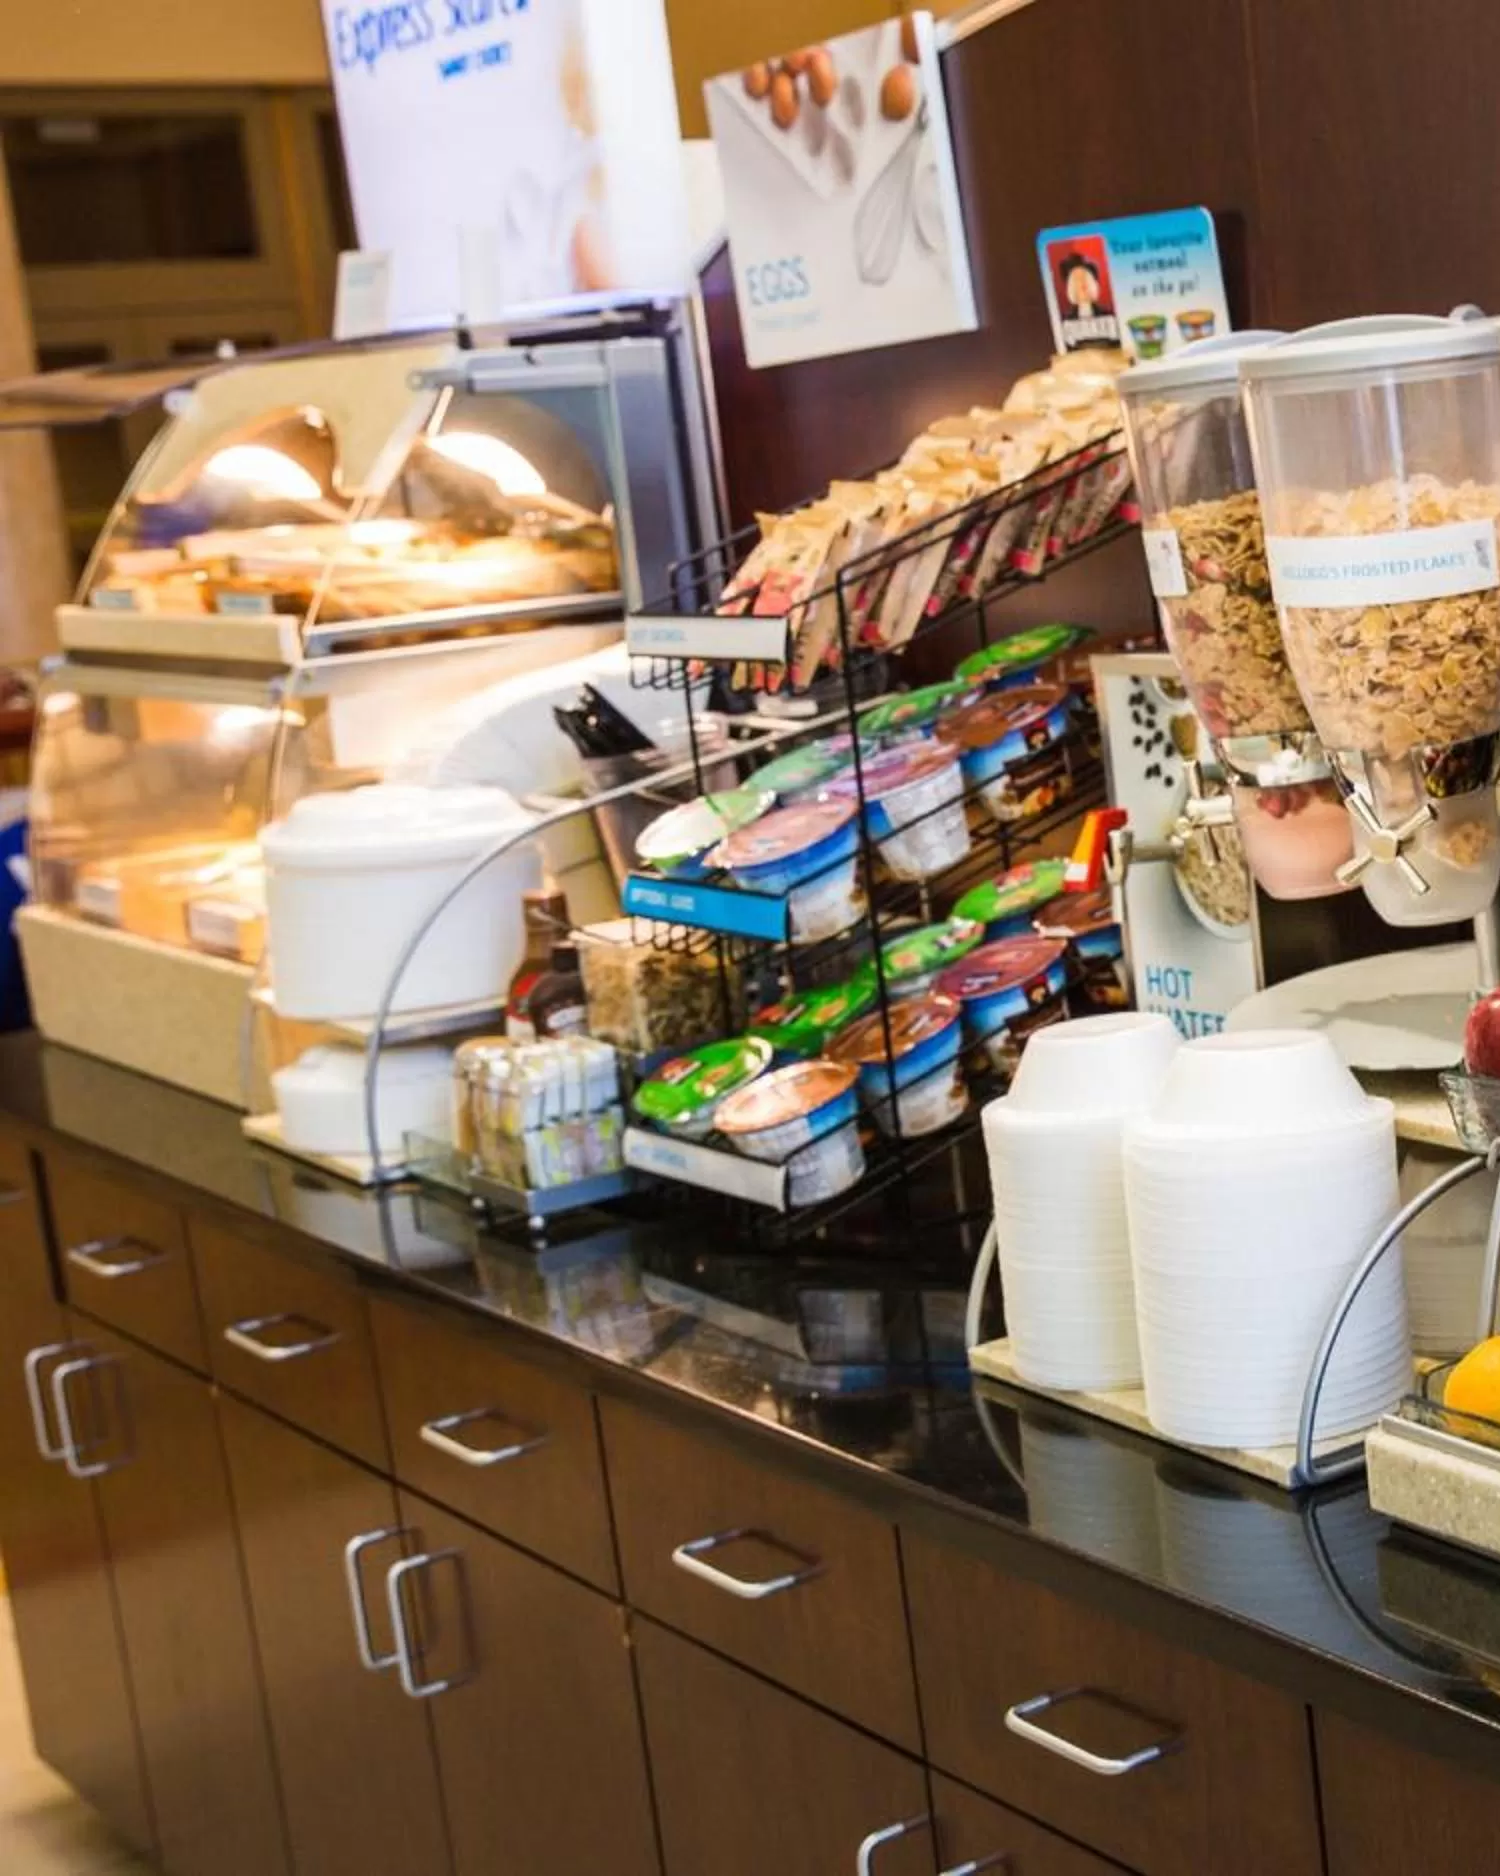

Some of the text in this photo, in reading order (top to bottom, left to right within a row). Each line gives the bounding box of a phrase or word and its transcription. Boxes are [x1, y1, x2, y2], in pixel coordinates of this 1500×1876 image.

[745, 256, 811, 306] EGGS
[1153, 278, 1174, 295] the
[1343, 558, 1411, 578] FROSTED
[1146, 964, 1192, 1001] HOT
[1147, 1004, 1225, 1041] ATER
